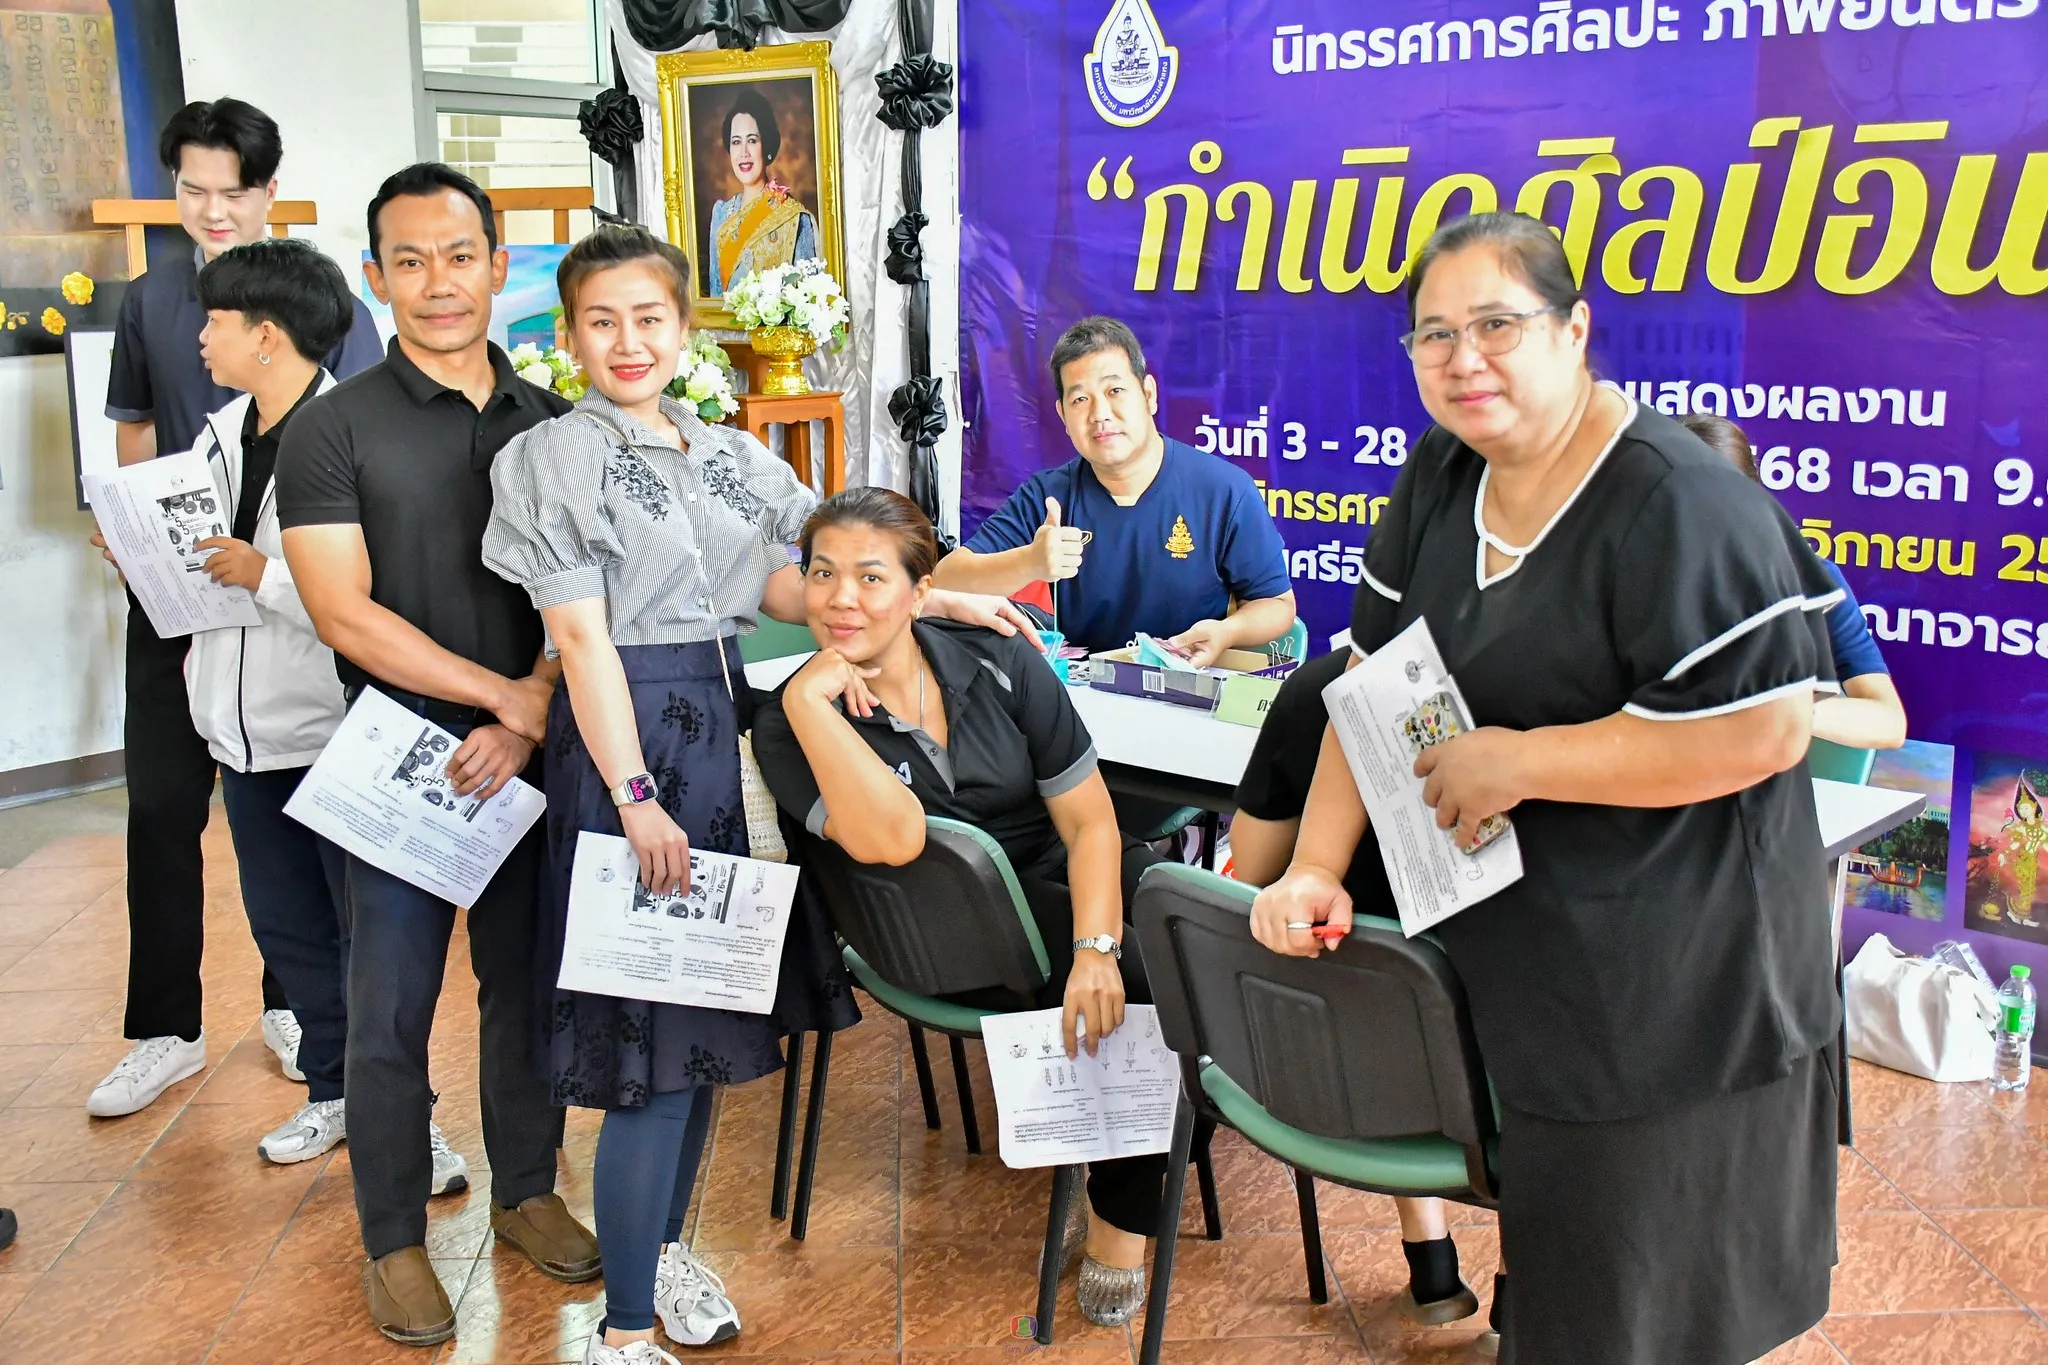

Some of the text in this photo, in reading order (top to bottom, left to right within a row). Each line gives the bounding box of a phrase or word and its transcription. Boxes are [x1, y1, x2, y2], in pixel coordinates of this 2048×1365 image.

[1272, 0, 1680, 75] นิทรรศการศิลปะ
[1195, 406, 2048, 507] วันที่ 3 - 28 68 เวลา 9.
